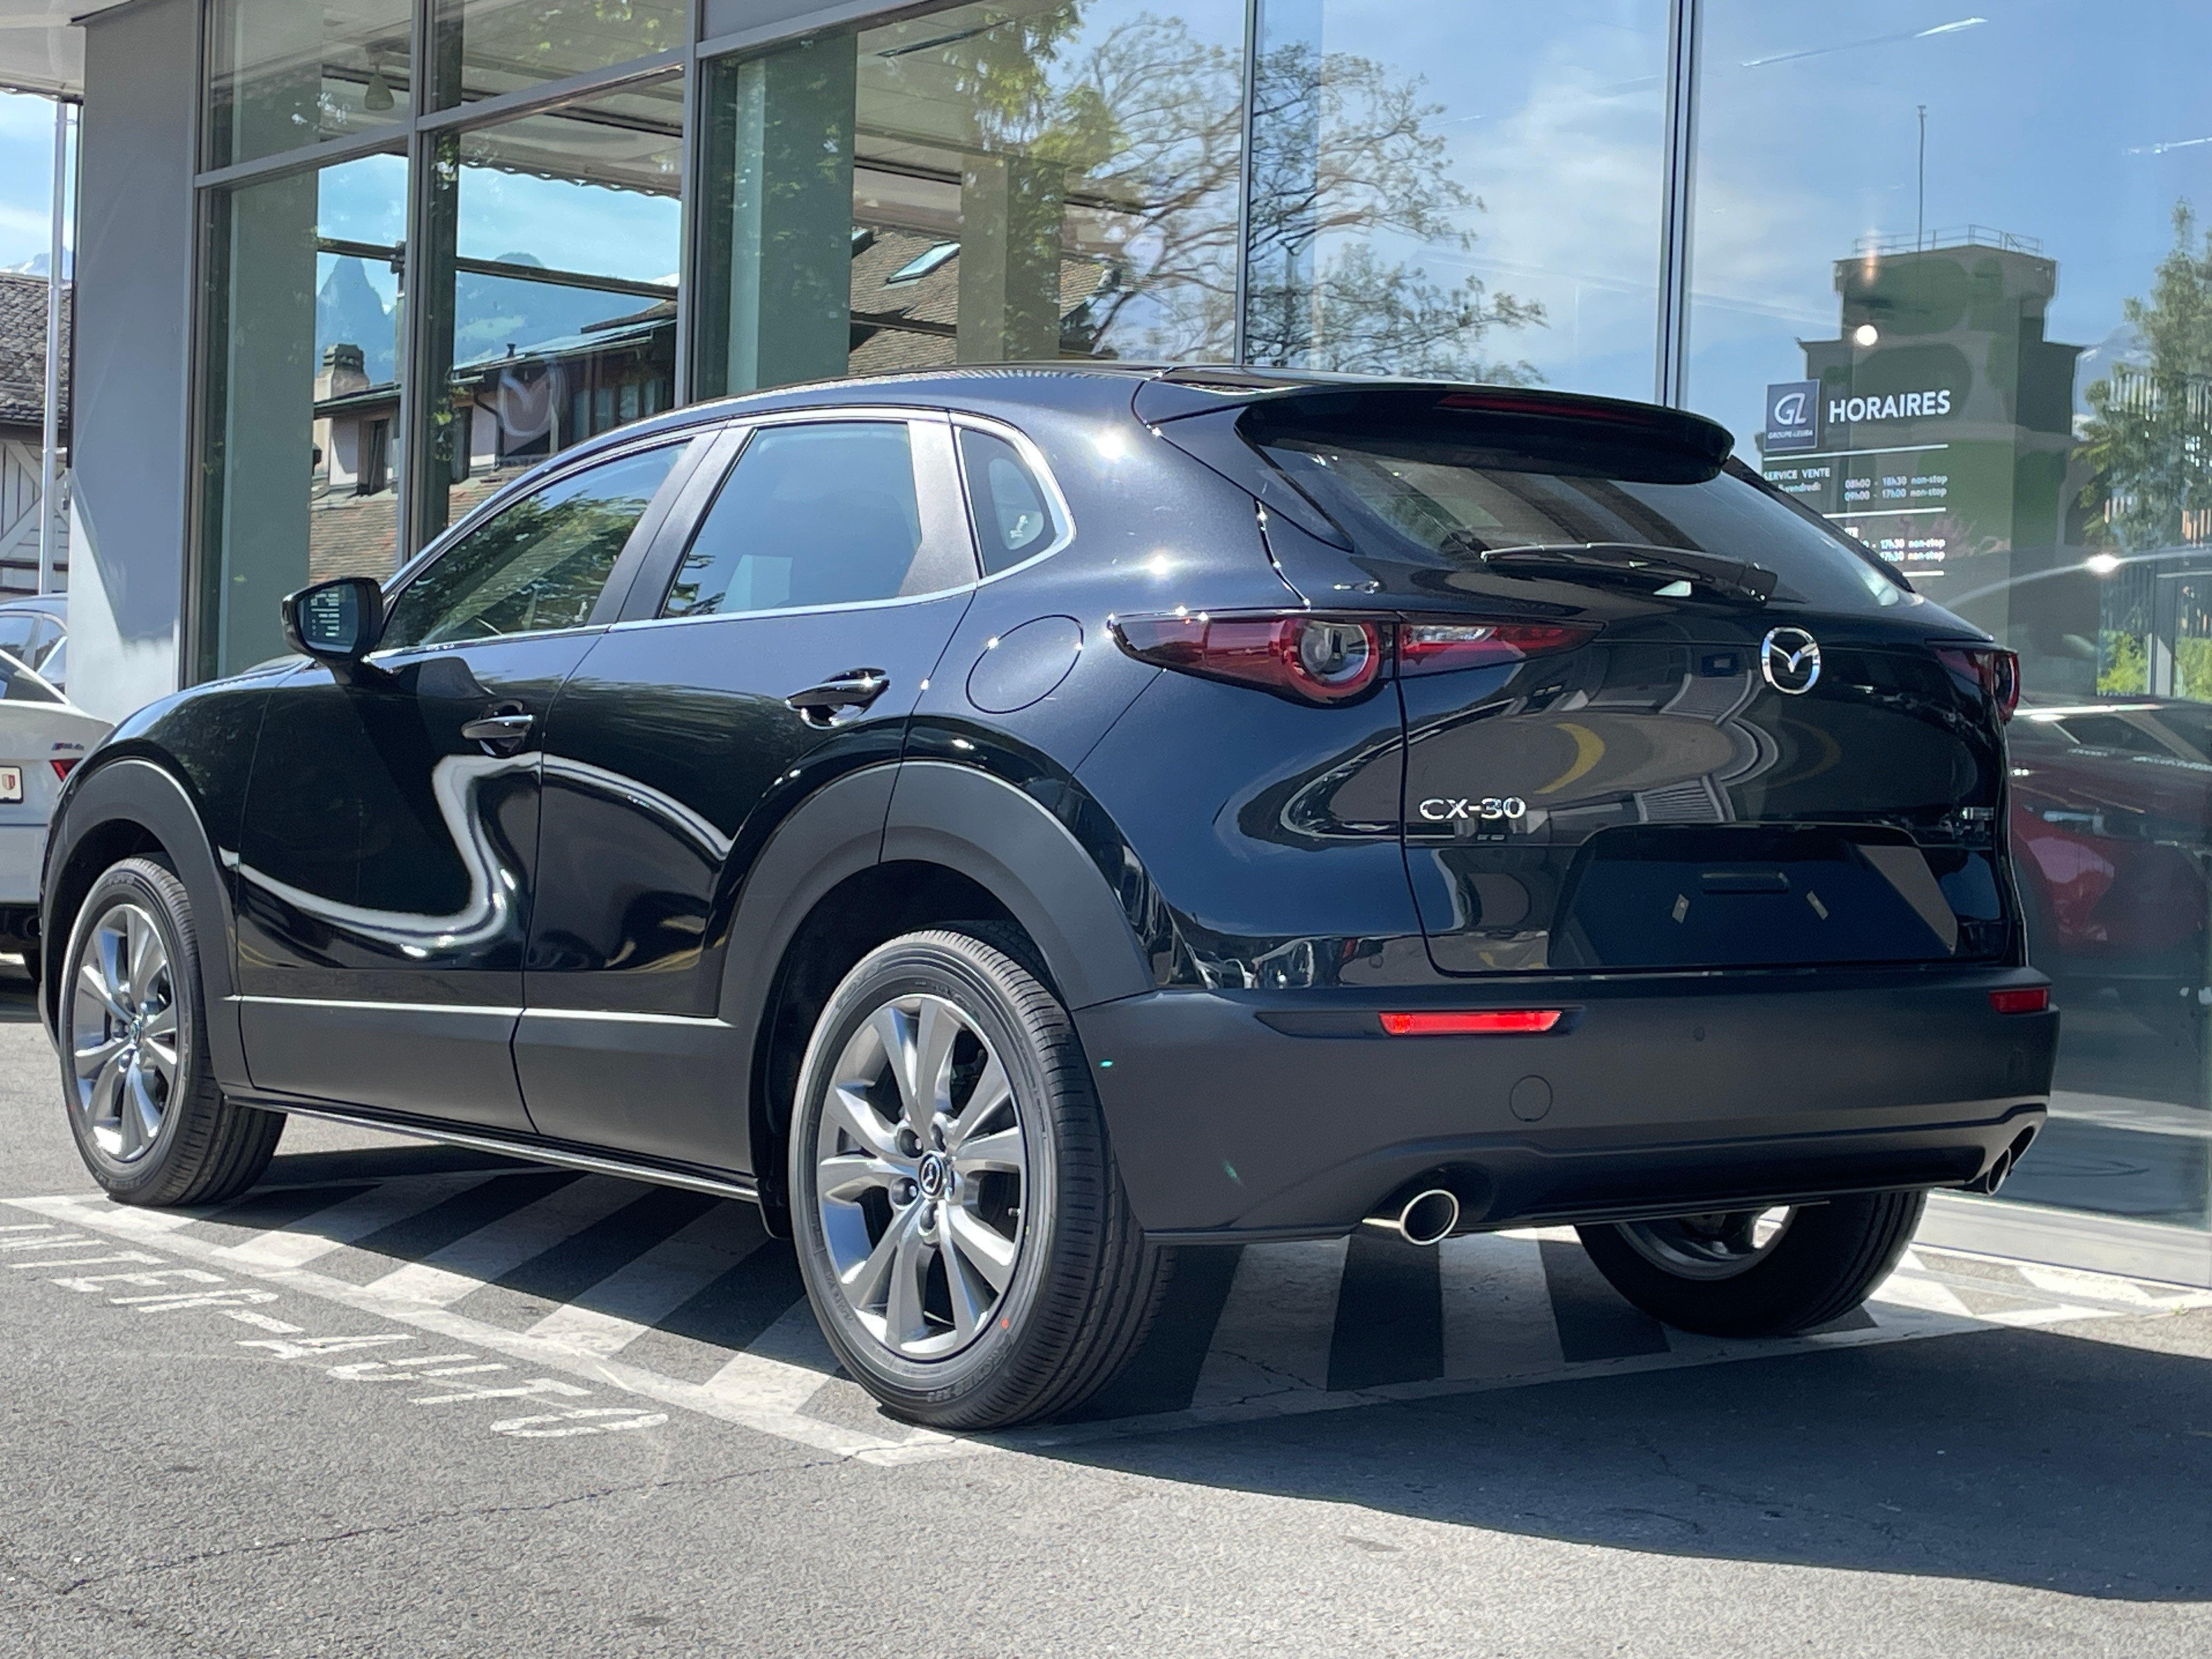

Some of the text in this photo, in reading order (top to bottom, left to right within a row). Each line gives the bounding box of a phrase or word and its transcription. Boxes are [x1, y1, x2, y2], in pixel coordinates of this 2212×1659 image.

[1829, 390, 1951, 424] HORAIRES
[1763, 467, 1831, 481] SERVICE VENTE
[1419, 797, 1526, 820] CX-30
